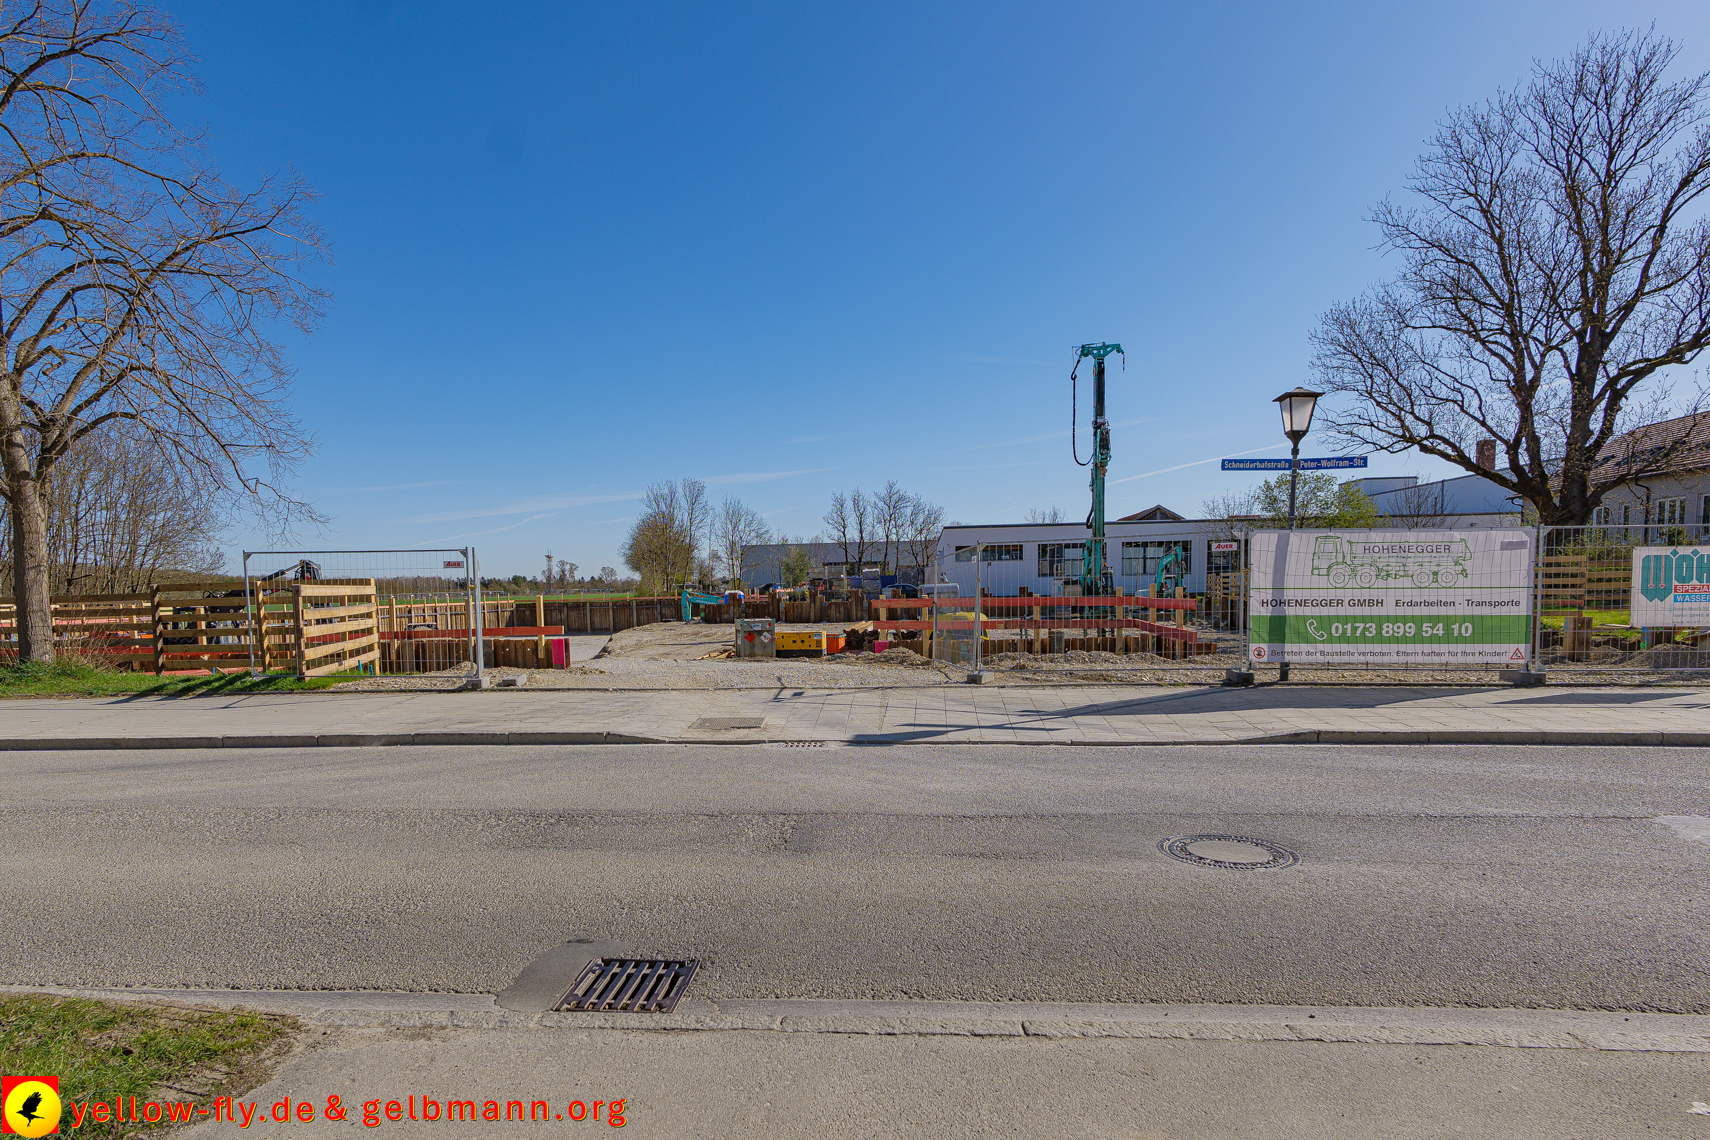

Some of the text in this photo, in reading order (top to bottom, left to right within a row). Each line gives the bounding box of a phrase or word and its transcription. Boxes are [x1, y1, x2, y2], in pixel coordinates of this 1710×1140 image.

[1224, 461, 1289, 469] Schneiderhofstraße
[1300, 459, 1365, 468] Peter-Wolfram-Str.
[1363, 544, 1451, 554] HOHENEGGER
[1676, 585, 1710, 593] SPEZIA
[1261, 599, 1344, 608] HOHENEGGER
[1348, 599, 1384, 608] GMBH
[1395, 599, 1456, 608] Erdarbeiten
[1465, 599, 1521, 609] Transporte
[1331, 622, 1473, 637] 0173 899 54 10
